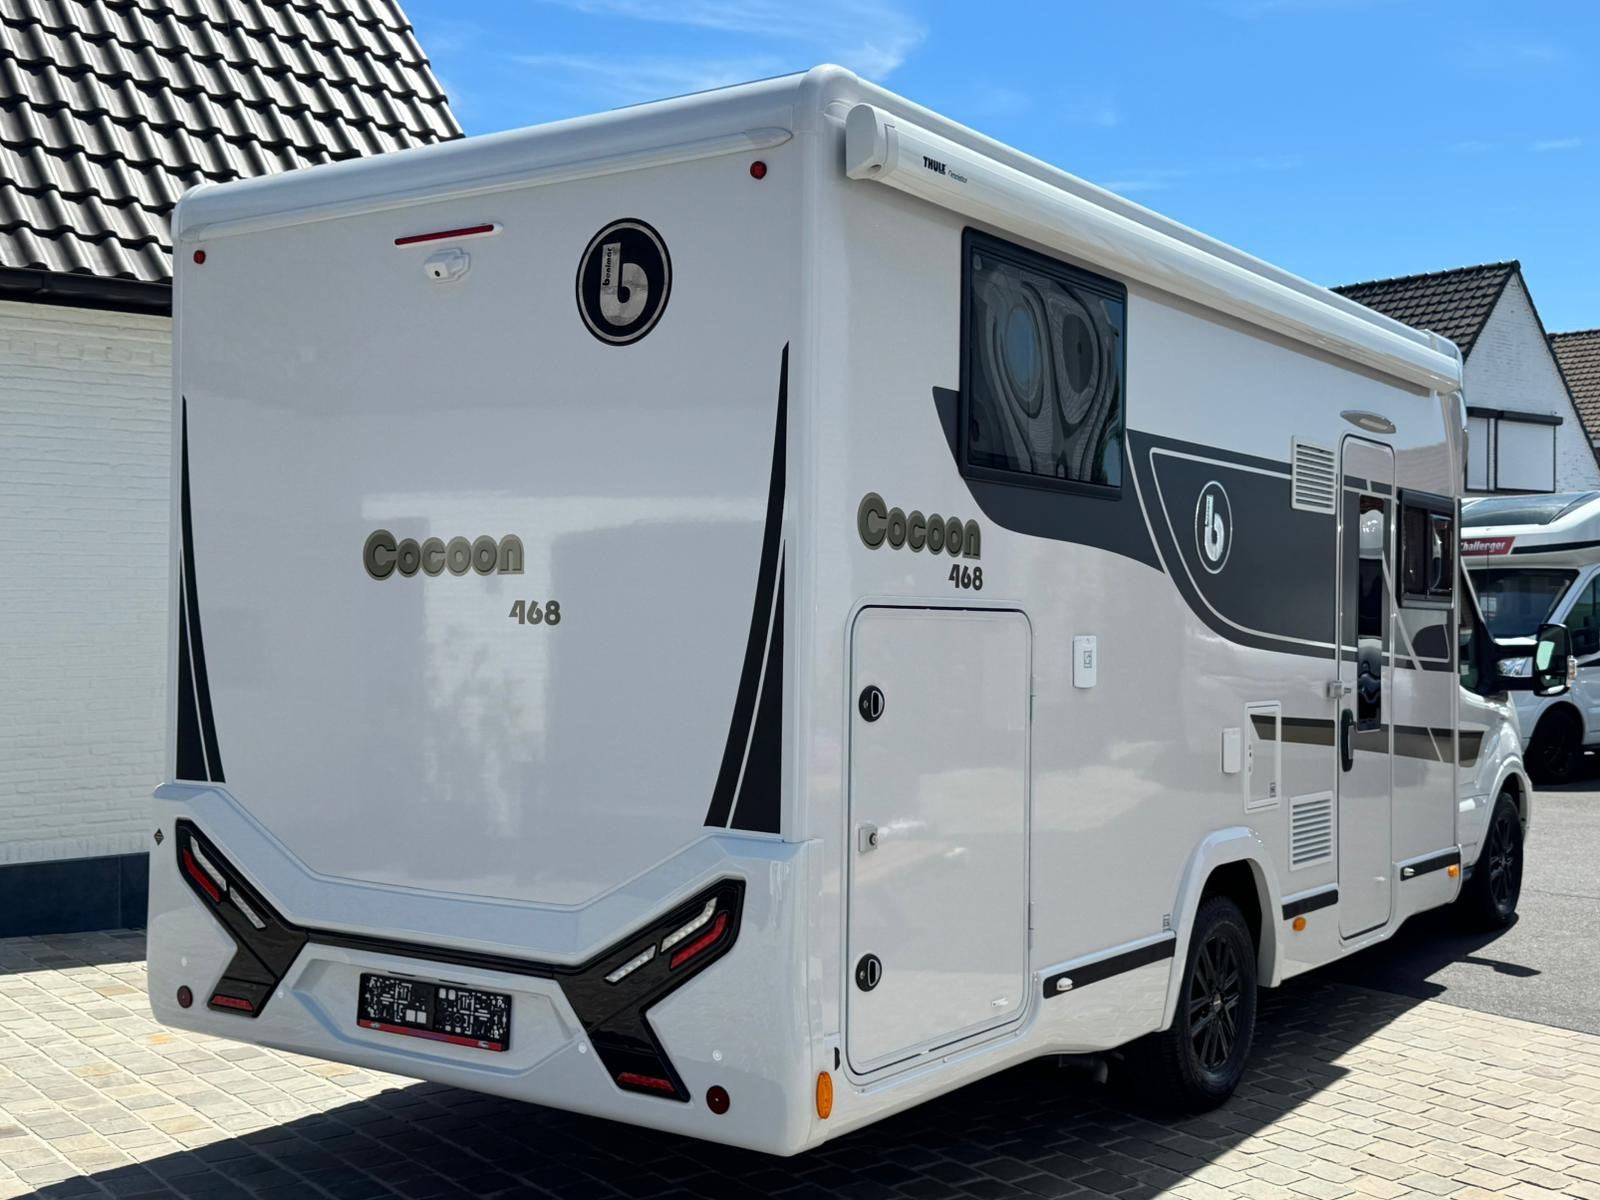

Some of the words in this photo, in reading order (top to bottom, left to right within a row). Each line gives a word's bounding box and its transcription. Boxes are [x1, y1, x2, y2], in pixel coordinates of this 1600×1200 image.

[923, 155, 947, 175] THULE
[857, 491, 981, 560] Cocoon
[363, 529, 525, 581] Cocoon
[948, 563, 983, 591] 468
[508, 600, 561, 626] 468
